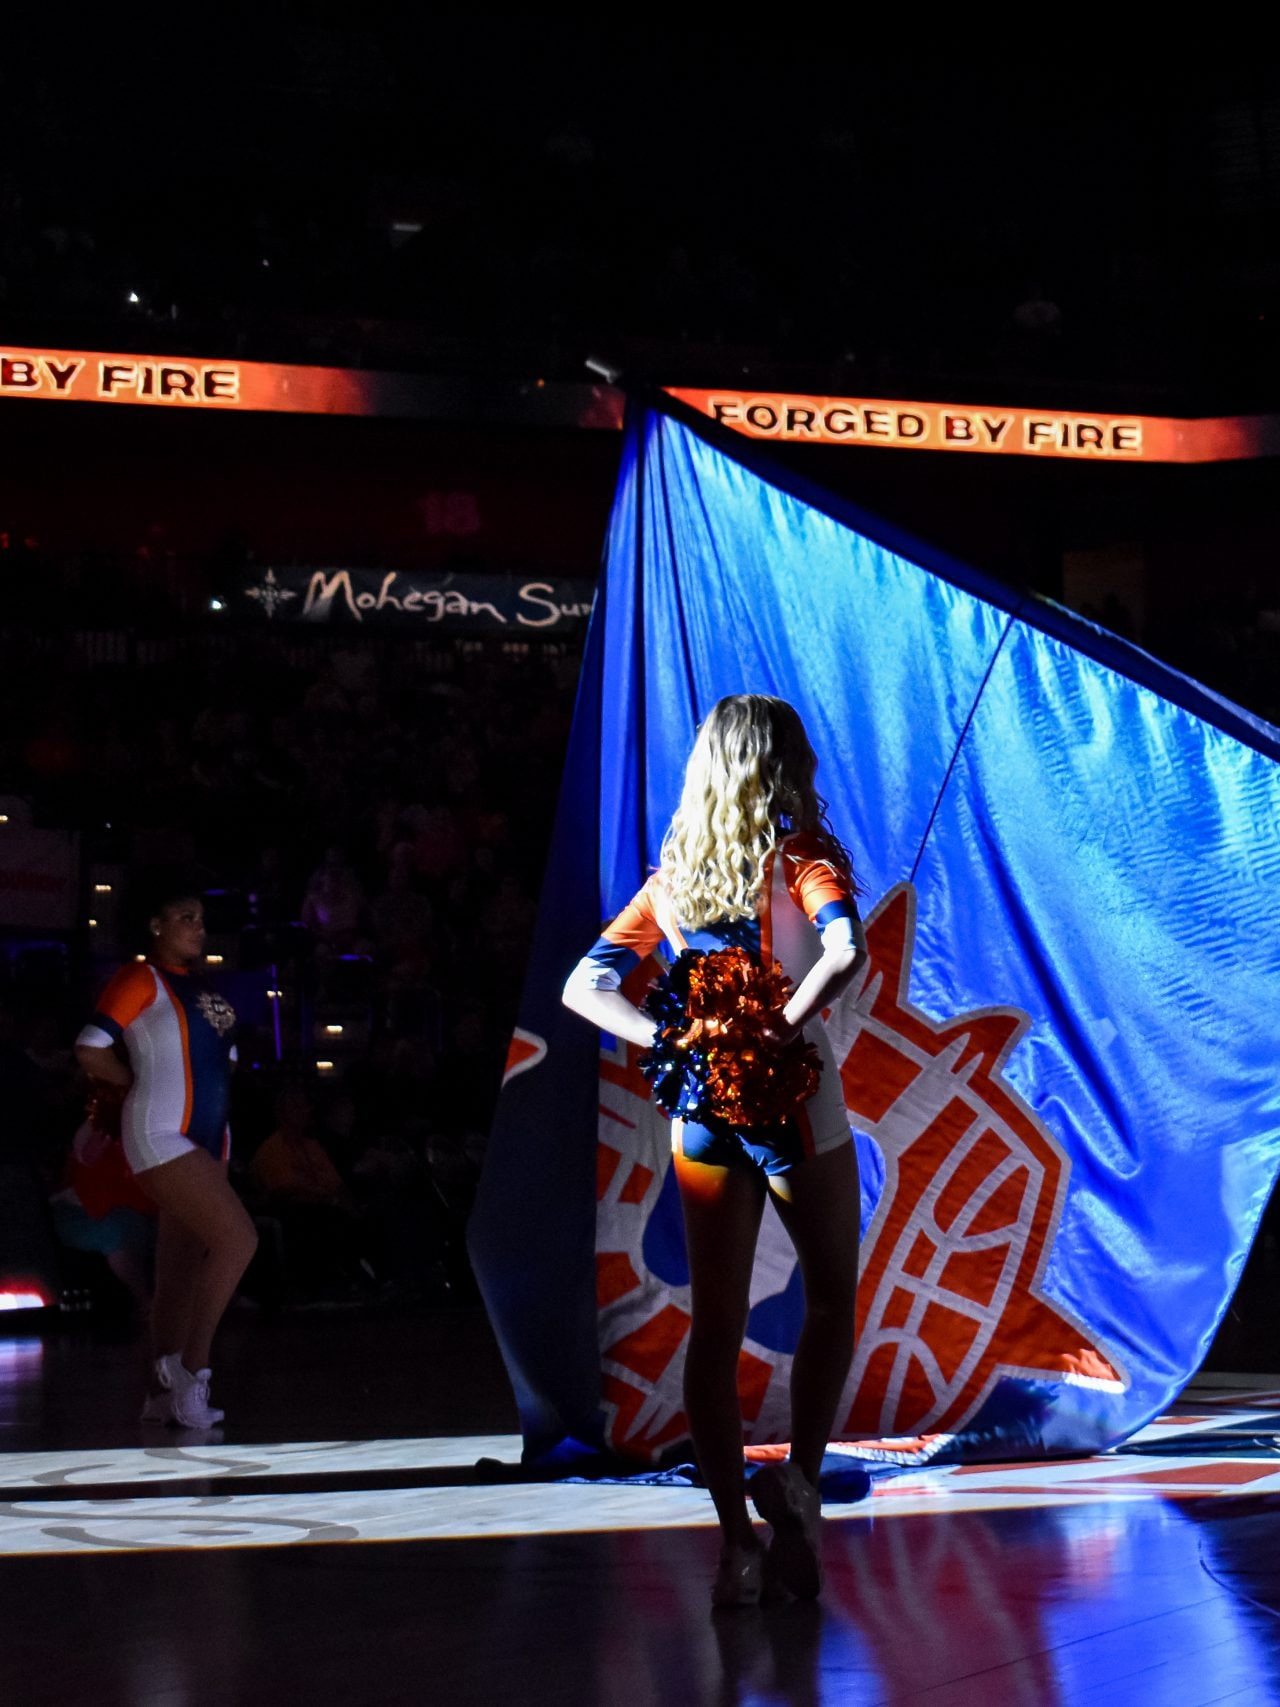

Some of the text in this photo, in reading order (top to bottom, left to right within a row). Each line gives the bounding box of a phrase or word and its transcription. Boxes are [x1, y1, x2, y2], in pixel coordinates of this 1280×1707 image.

[0, 354, 240, 403] BY FIRE
[708, 396, 1143, 457] FORGED BY FIRE
[303, 570, 507, 623] Mohegan
